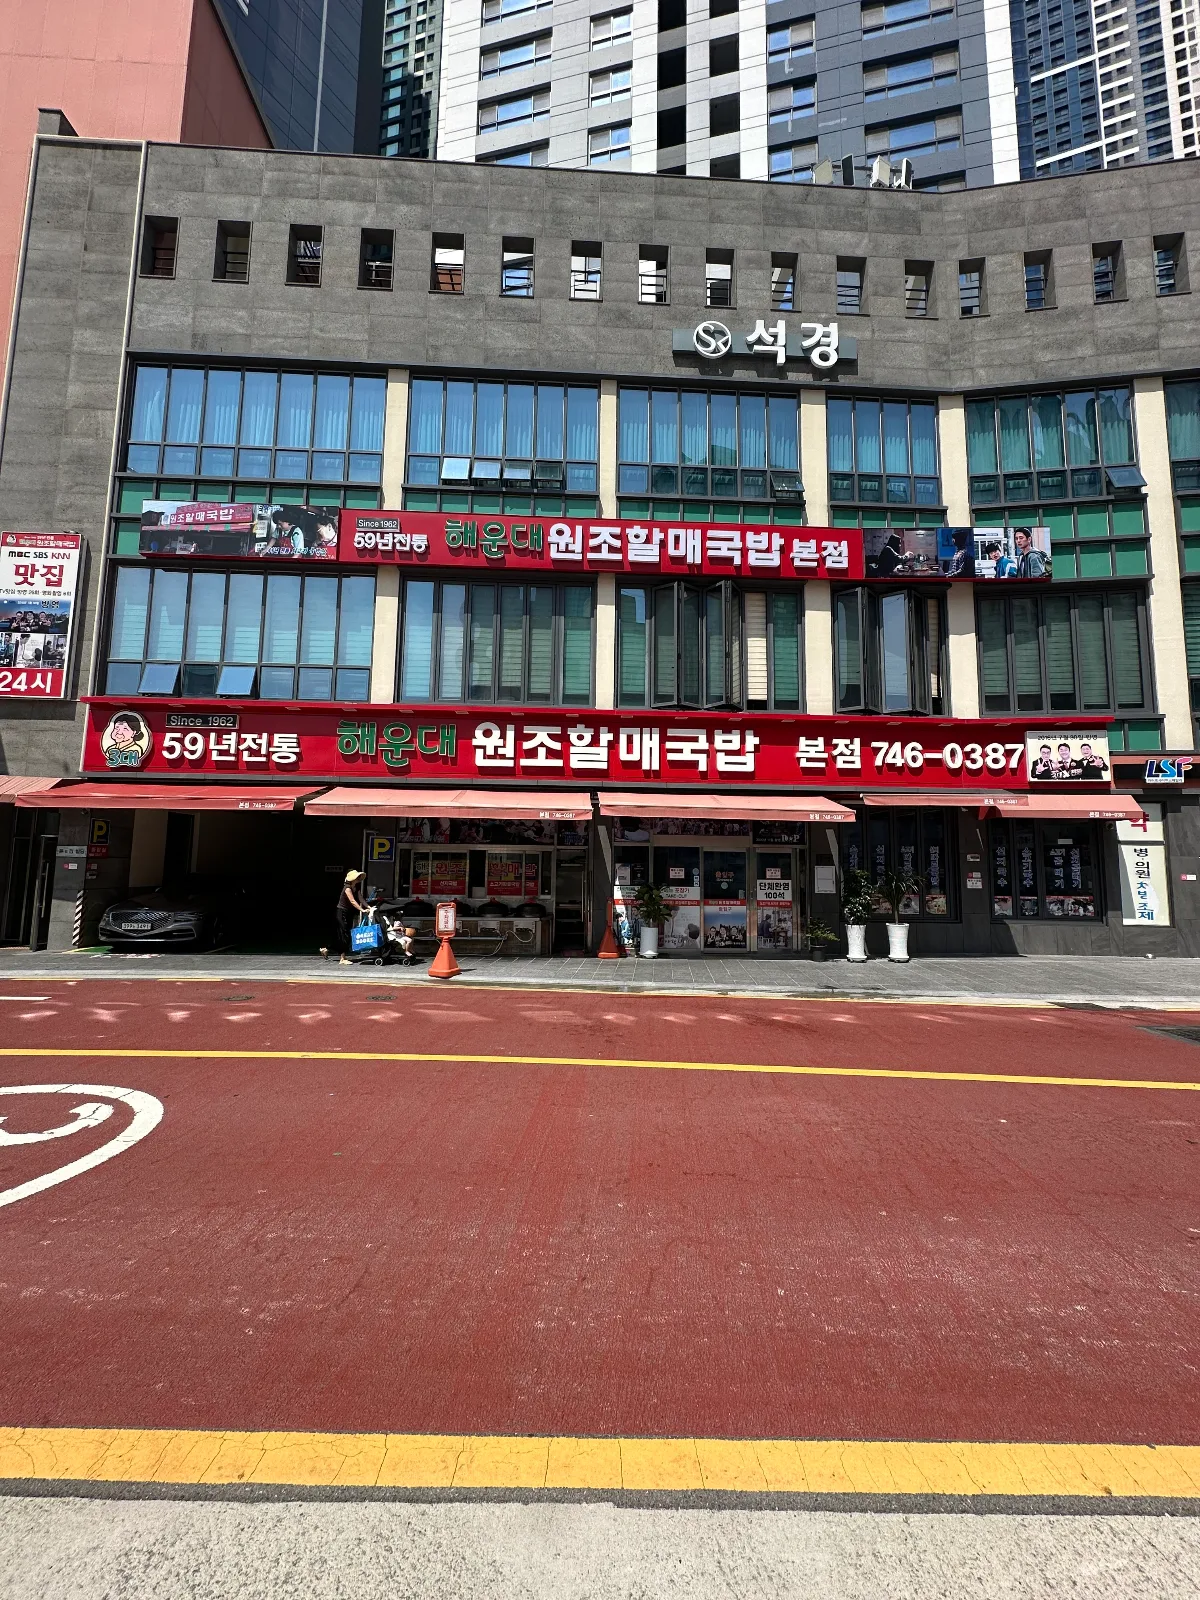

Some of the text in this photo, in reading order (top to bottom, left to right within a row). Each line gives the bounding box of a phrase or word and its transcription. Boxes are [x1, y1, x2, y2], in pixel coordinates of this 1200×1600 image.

[746, 320, 838, 369] 석경
[170, 508, 234, 524] 원조할매국밥
[358, 520, 397, 528] Since 1962
[444, 518, 849, 569] 해운대 원조할매국밥 본점
[14, 563, 64, 587] 맛집
[0, 671, 52, 693] 24시
[170, 715, 234, 727] Since 1962
[162, 732, 300, 764] 59년전통
[336, 720, 1025, 772] 해운대 원조할매국밥 본점 746-0387
[106, 750, 140, 767] 3대
[1146, 757, 1193, 777] LSF
[93, 821, 107, 843] P
[373, 838, 390, 859] P
[759, 882, 789, 890] 단체환영
